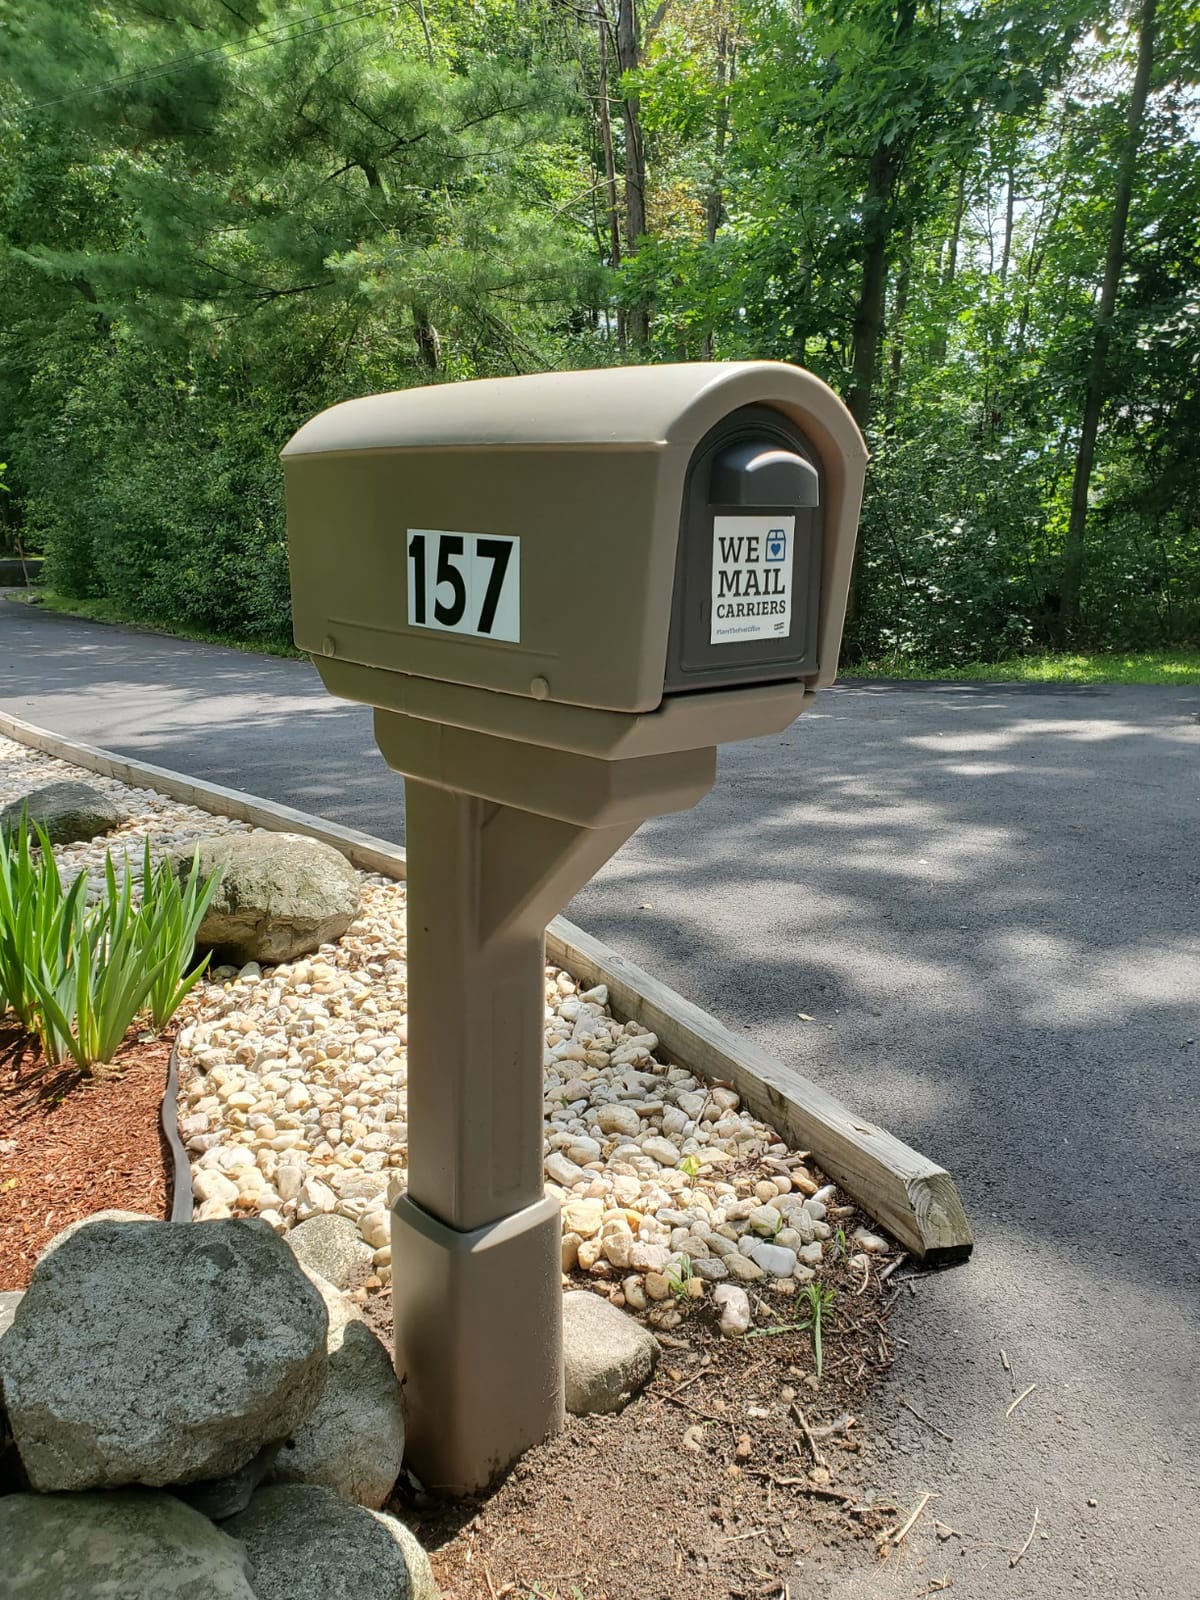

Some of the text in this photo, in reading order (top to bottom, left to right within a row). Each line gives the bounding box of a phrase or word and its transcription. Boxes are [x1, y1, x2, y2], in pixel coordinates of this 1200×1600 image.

[718, 536, 760, 563] WE
[409, 535, 513, 633] 157
[717, 568, 785, 598] MAIL
[716, 600, 786, 619] CARRIERS
